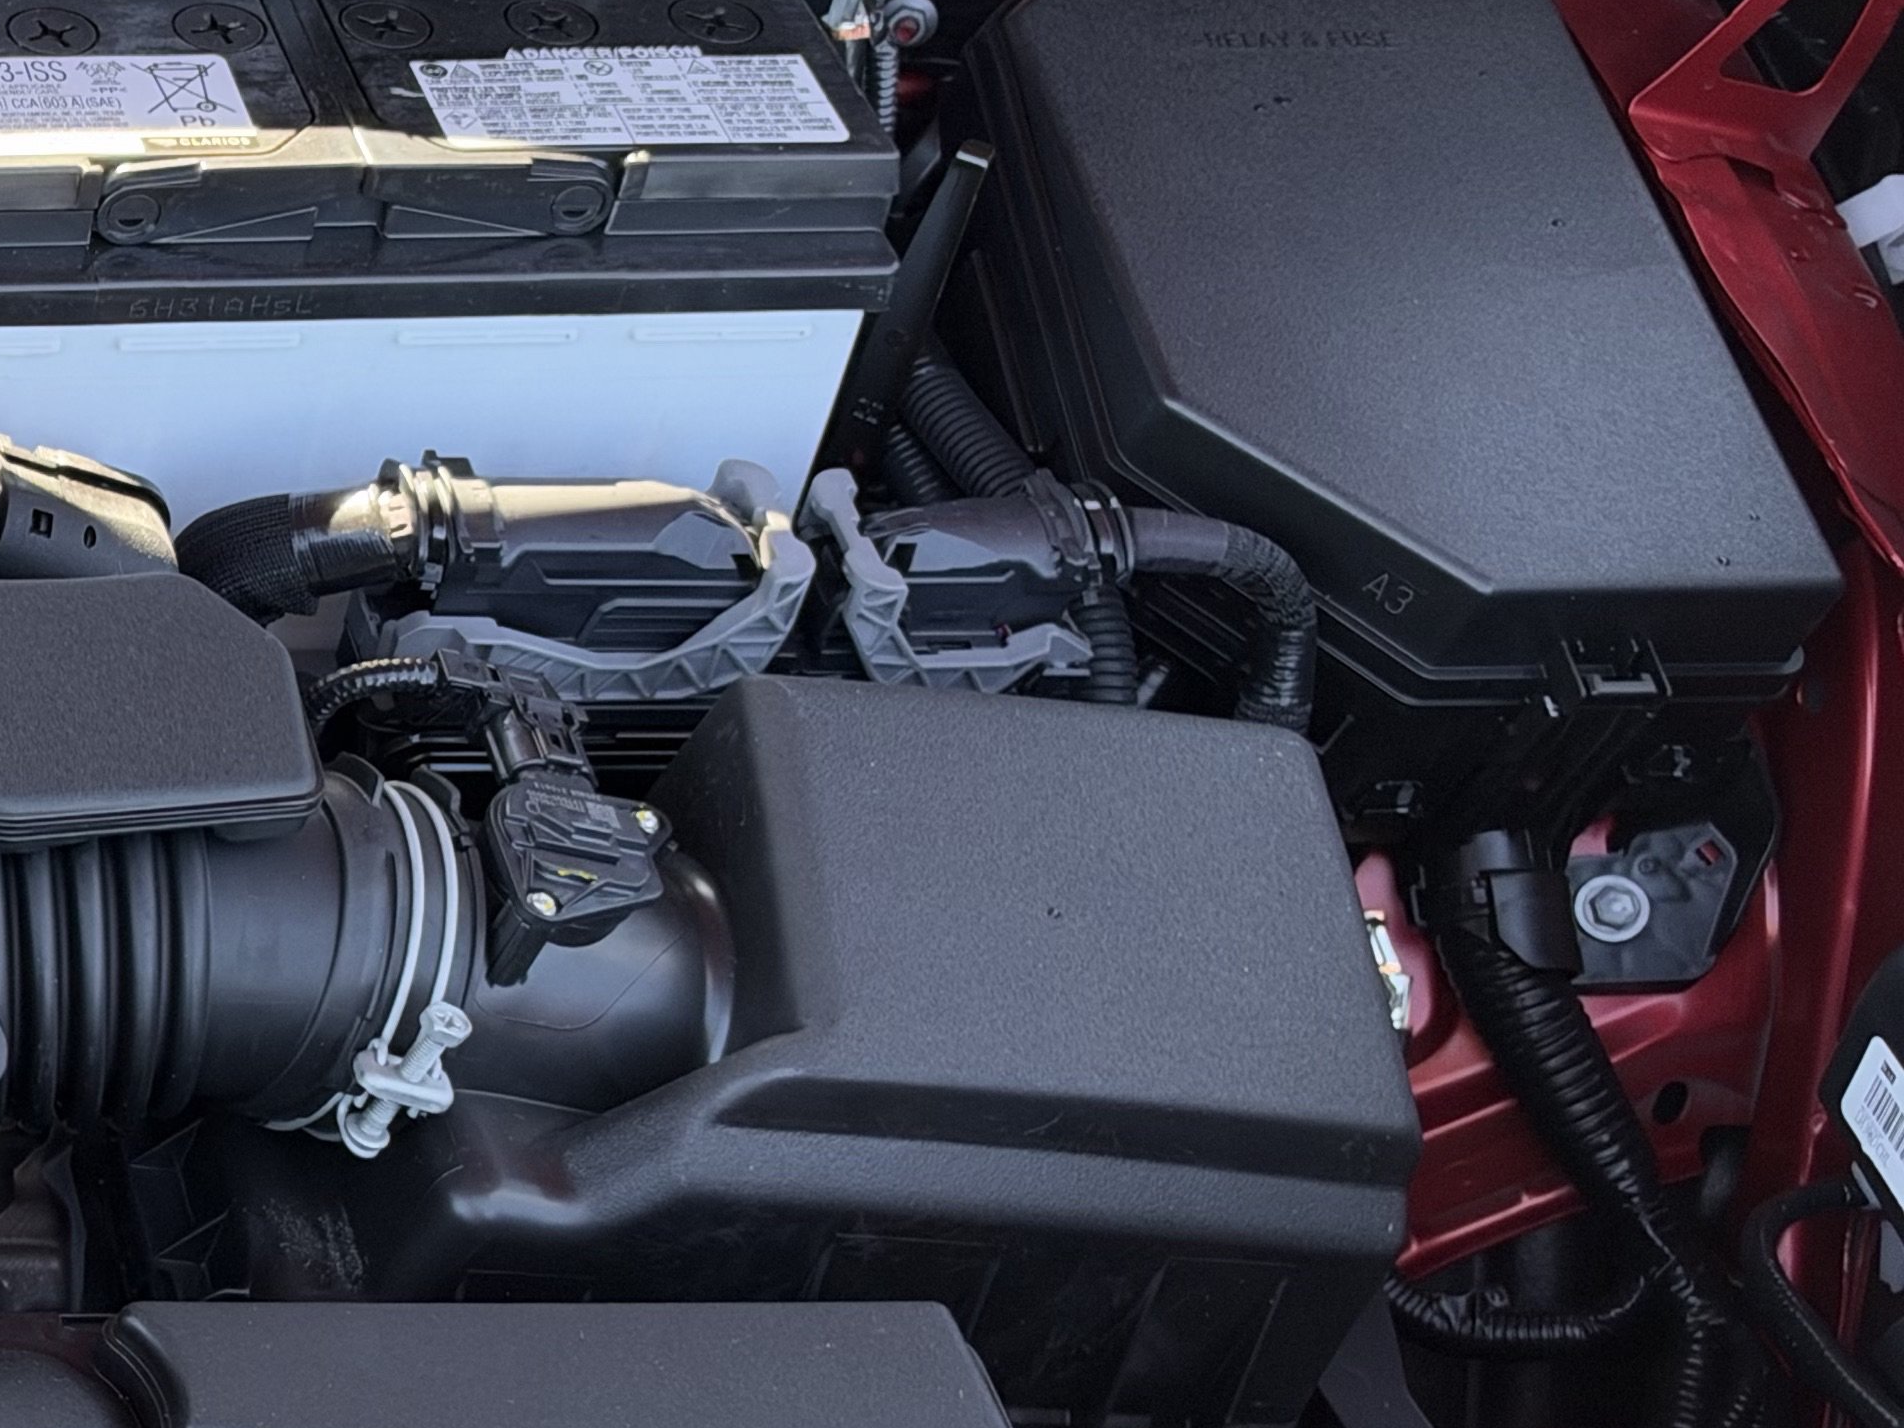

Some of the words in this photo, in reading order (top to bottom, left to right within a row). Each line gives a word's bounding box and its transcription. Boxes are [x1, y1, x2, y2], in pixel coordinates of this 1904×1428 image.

[1326, 30, 1398, 49] FUSE
[522, 46, 703, 60] DANGER/POISON
[10, 96, 40, 110] CCA
[42, 96, 68, 109] 603
[85, 96, 122, 110] (SAE)
[179, 114, 217, 128] Pb
[177, 136, 251, 148] CLARIOS
